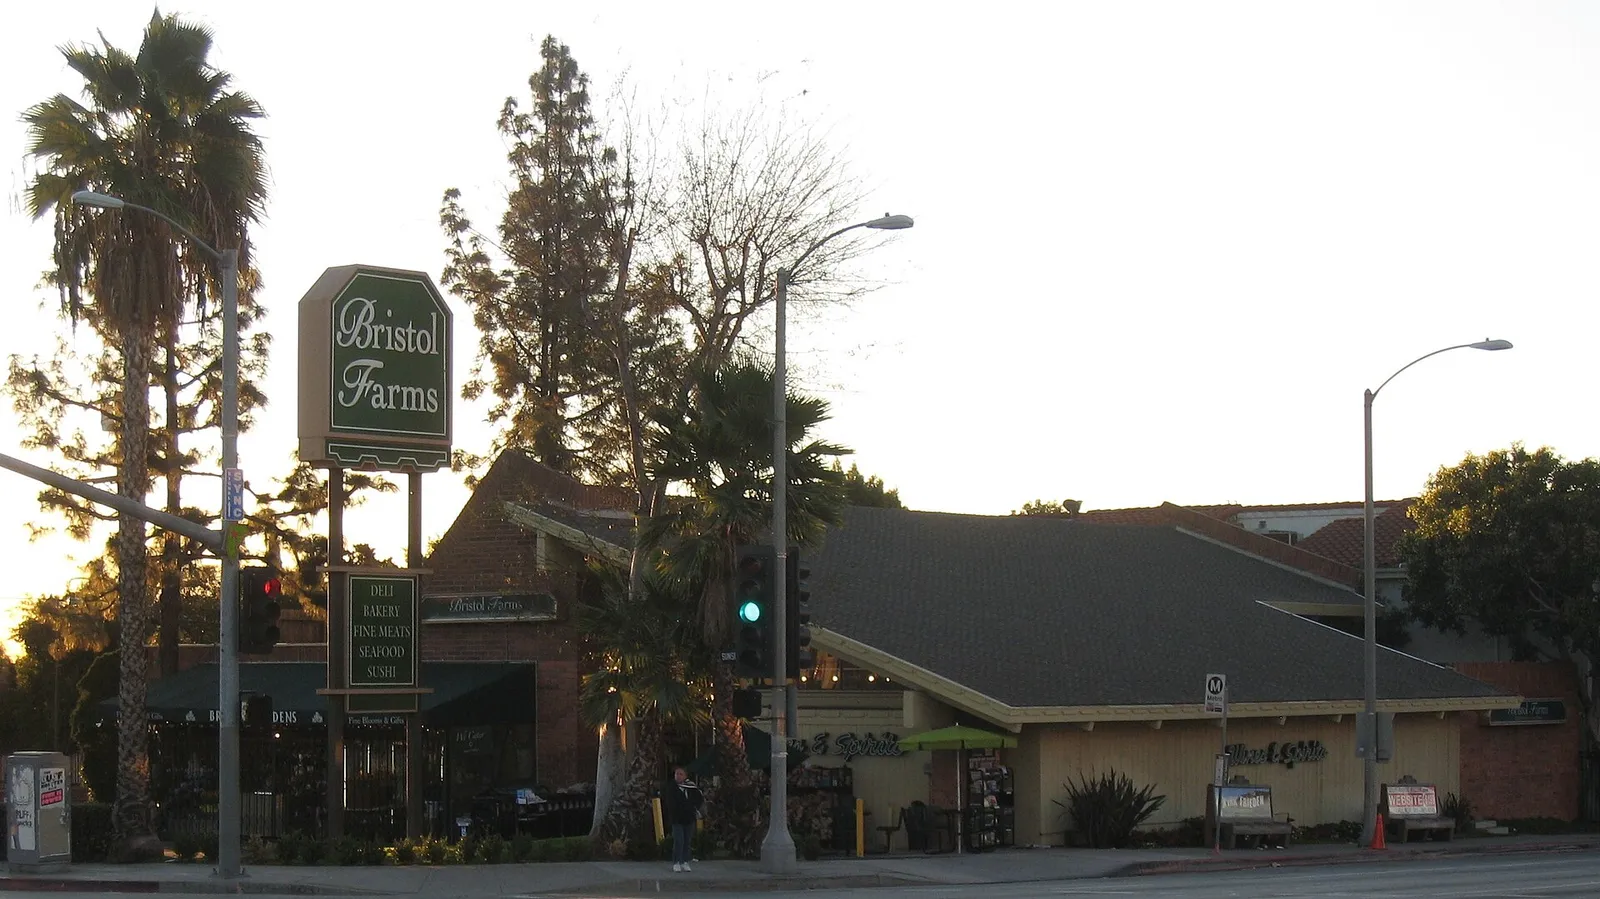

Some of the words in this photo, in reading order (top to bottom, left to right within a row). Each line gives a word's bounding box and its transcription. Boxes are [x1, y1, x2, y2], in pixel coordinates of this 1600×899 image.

[336, 297, 439, 355] Bristol
[338, 358, 438, 413] Farms
[370, 584, 394, 597] DELI
[363, 604, 400, 618] BAKERY
[449, 596, 485, 612] Bristol
[353, 624, 376, 638] FINE
[379, 624, 411, 638] MEATS
[359, 645, 405, 659] SEAFOOD
[367, 665, 396, 679] SUSHI
[272, 711, 298, 724] DENS
